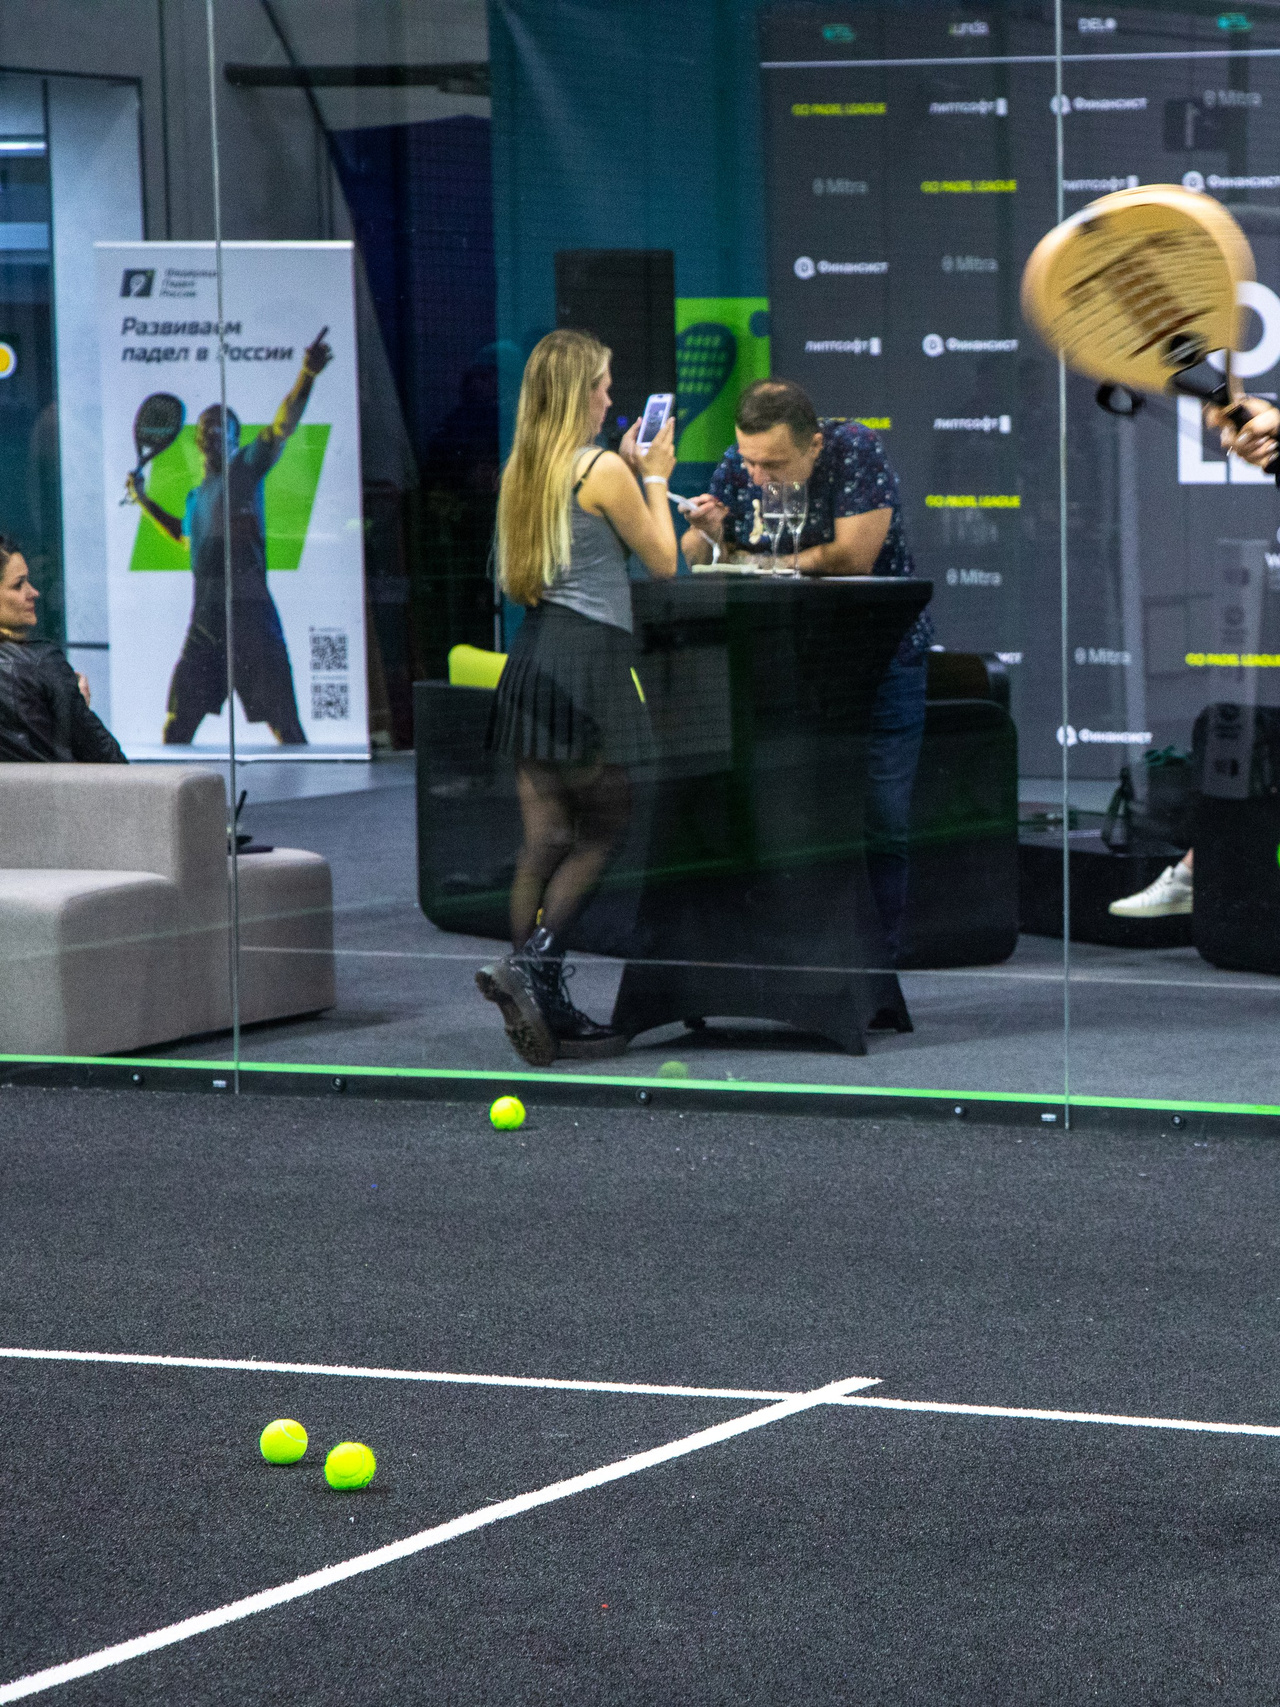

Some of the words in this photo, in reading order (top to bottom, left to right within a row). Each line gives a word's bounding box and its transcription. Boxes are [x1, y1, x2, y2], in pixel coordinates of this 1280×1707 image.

[121, 345, 190, 363] падел
[195, 346, 208, 361] в
[960, 568, 1002, 586] Mitra
[1088, 649, 1133, 666] Mitra
